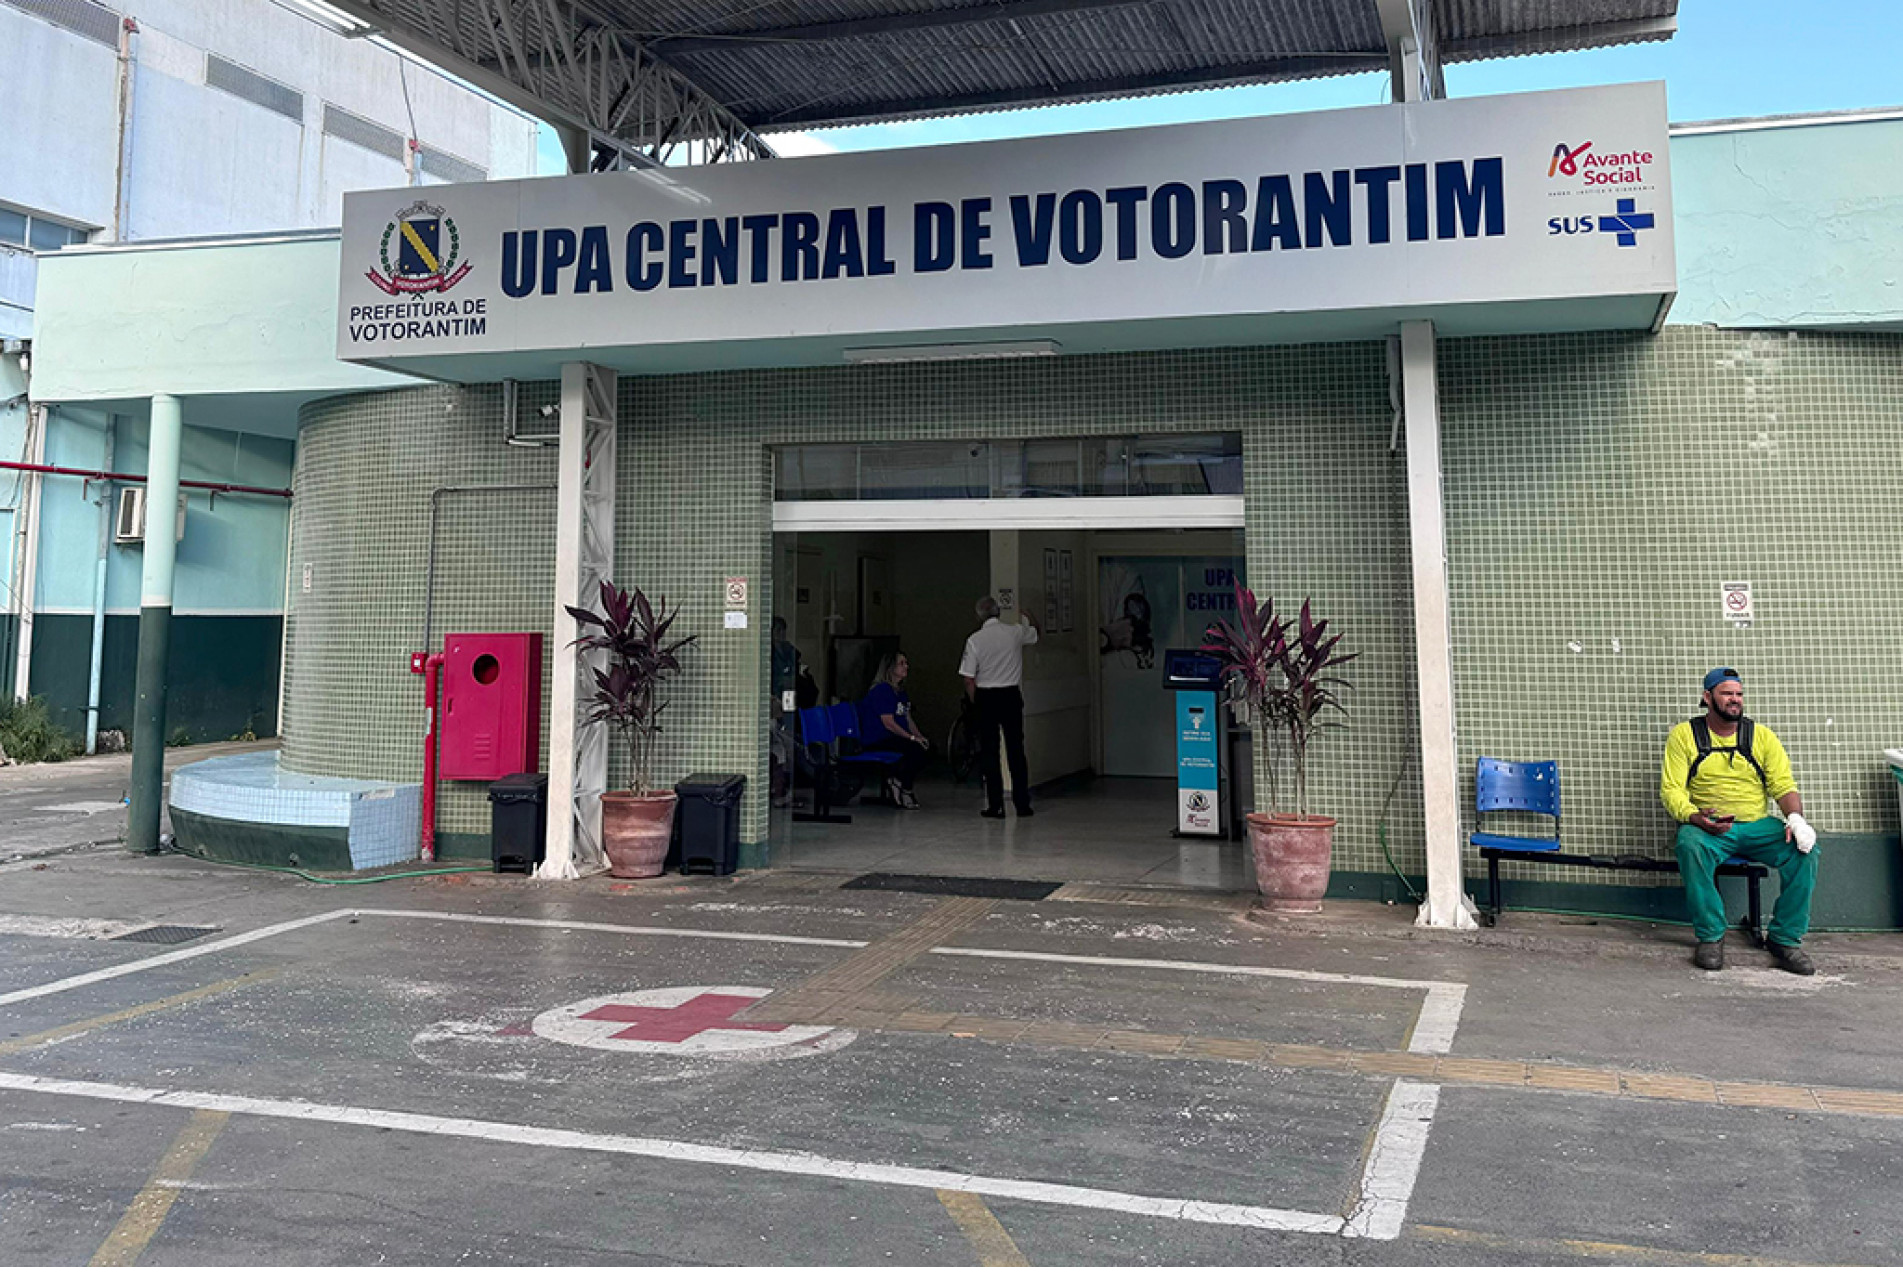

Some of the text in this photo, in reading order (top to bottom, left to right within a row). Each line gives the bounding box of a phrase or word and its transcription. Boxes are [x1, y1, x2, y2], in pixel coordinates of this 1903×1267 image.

[1582, 150, 1653, 168] Avante
[1583, 166, 1643, 187] Social
[501, 157, 1506, 298] UPA CENTRAL DE VOTORANTIM
[1547, 215, 1594, 235] SUS
[350, 298, 487, 321] PREFEITURA DE
[349, 317, 487, 343] VOTORANTIM
